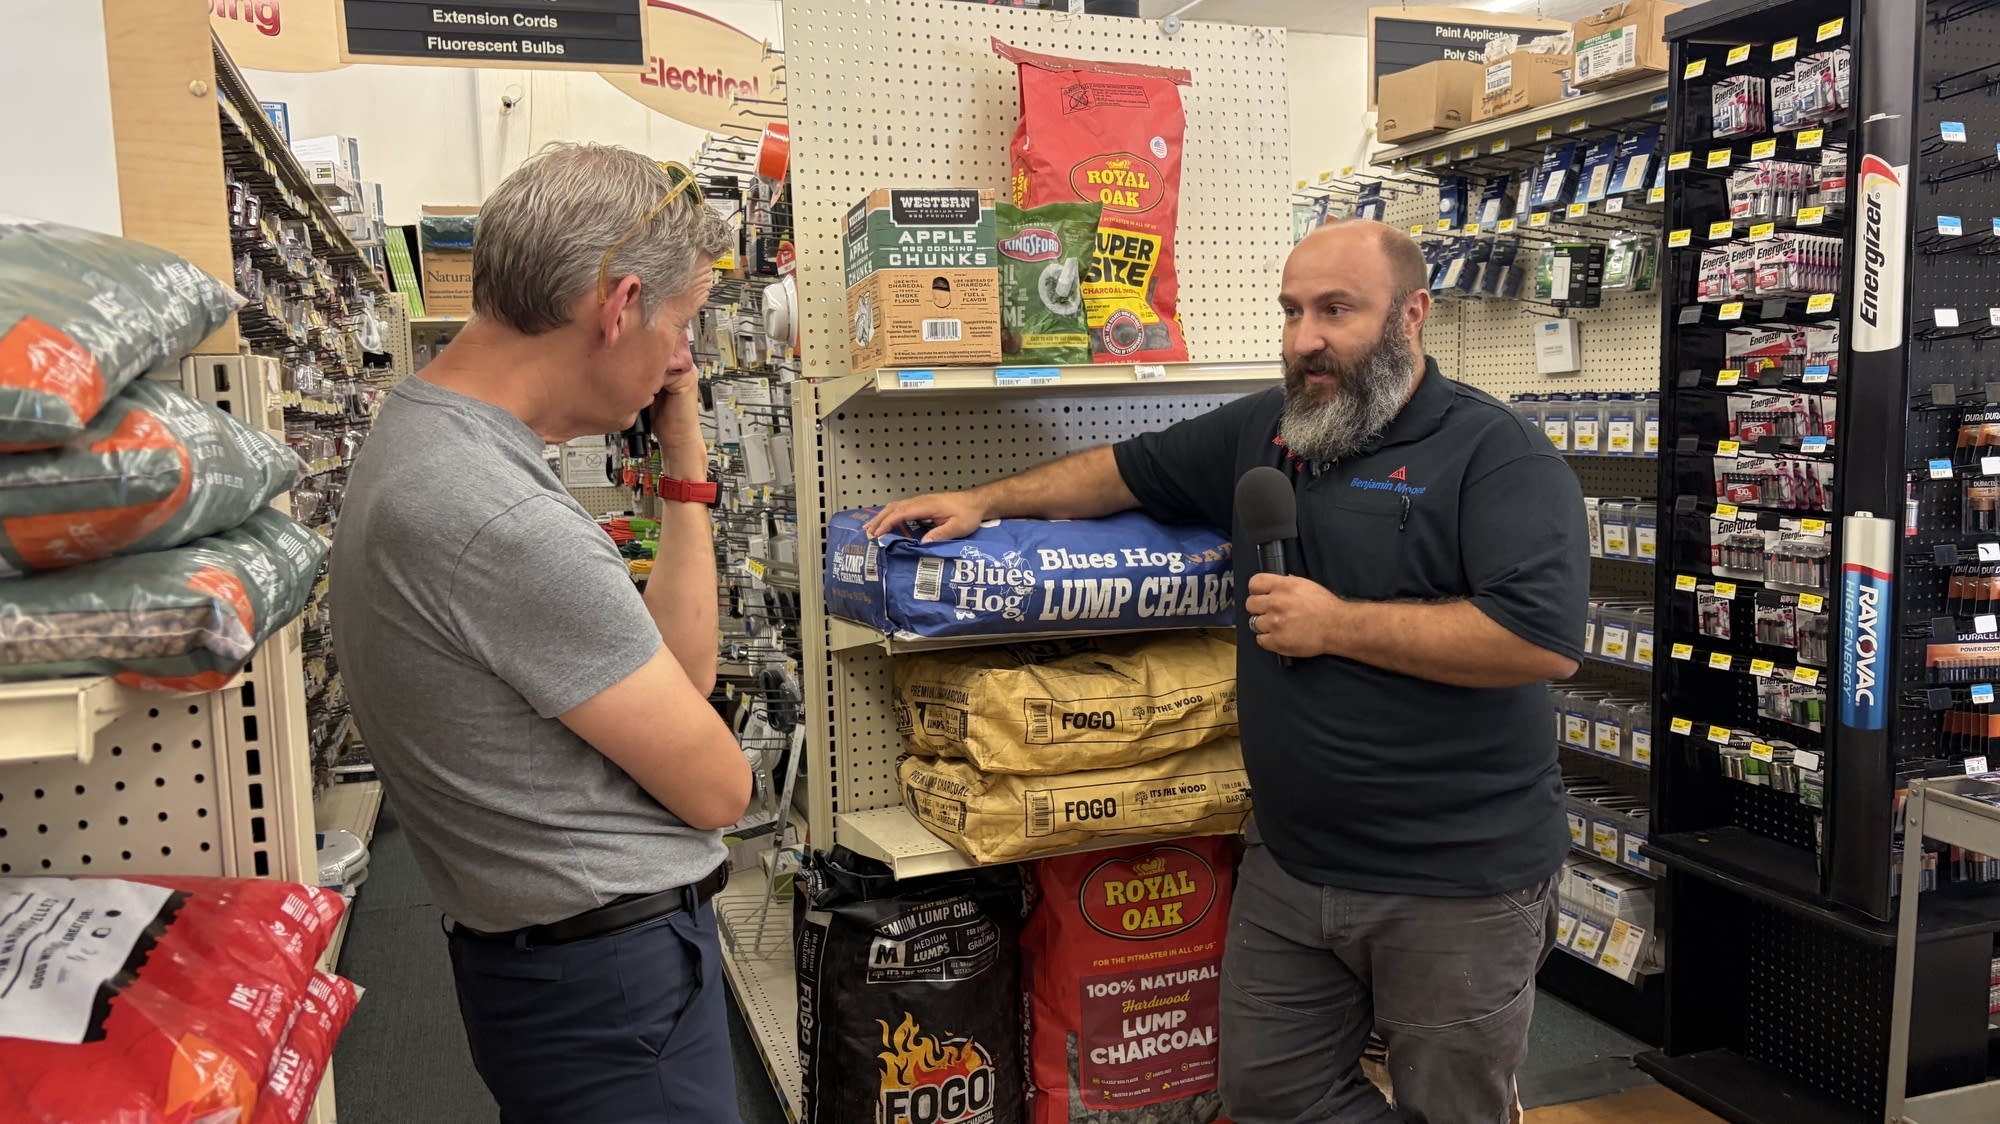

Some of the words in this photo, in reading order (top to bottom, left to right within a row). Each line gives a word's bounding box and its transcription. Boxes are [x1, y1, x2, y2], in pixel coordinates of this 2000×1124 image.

[433, 8, 509, 26] Extension
[513, 12, 558, 28] Cords
[1435, 26, 1462, 39] Paint
[427, 36, 518, 53] Fluorescent
[521, 40, 565, 55] Bulbs
[1444, 49, 1466, 62] Poly
[639, 56, 760, 100] Electrical
[1798, 56, 1831, 82] Energizer
[1714, 79, 1746, 104] Energizer
[1087, 169, 1150, 190] ROYAL
[899, 196, 970, 208] WESTERN
[1100, 188, 1140, 208] OAK
[850, 236, 869, 262] APPLE
[898, 230, 977, 244] APPLE
[902, 245, 924, 253] BBQ
[1004, 233, 1060, 256] KINGSFORD
[1096, 232, 1155, 262] UPER
[889, 253, 988, 266] CHUNKS
[1756, 238, 1797, 261] Energizer
[1859, 191, 1886, 328] Energizer
[848, 259, 873, 287] CHUNKS
[1083, 255, 1150, 288] SIZE
[1082, 286, 1123, 295] CHARCOAL
[1750, 331, 1781, 346] Energizer
[1751, 397, 1780, 409] Energizer
[1824, 424, 1832, 432] 12
[1736, 457, 1765, 471] Energizer
[1351, 477, 1393, 492] Benjamin
[953, 558, 1037, 587] Blues
[1037, 548, 1118, 571] Blues
[1120, 547, 1186, 574] Hog
[956, 586, 1025, 620] Hog
[1038, 577, 1134, 622] LUMP
[1136, 569, 1236, 619] CHARC
[1845, 579, 1856, 625] HIGH
[1855, 584, 1880, 706] RAYOVAC
[1982, 645, 2000, 653] BOOST
[1843, 626, 1854, 698] ENERGY
[1157, 703, 1172, 713] THE
[1174, 695, 1204, 709] WOOD
[1062, 710, 1116, 731] FOGO
[1149, 789, 1162, 798] IT'S
[1163, 787, 1177, 797] THE
[1178, 783, 1207, 794] WOOD
[1064, 797, 1118, 823] FOGO
[1103, 869, 1197, 907] ROYAL
[918, 906, 951, 927] LUMP
[1121, 901, 1184, 932] OAK
[61, 919, 84, 942] GREAT
[912, 931, 949, 951] MEDIUM
[874, 944, 898, 965] M
[912, 941, 951, 963] LUMPS
[1092, 959, 1110, 968] FOR
[1111, 956, 1126, 965] THE
[1126, 950, 1169, 963] PITMASTER
[1168, 949, 1177, 957] IN
[1178, 946, 1193, 955] ALL
[1193, 944, 1203, 953] OF
[1204, 943, 1214, 951] US
[916, 966, 942, 974] WOOD
[1086, 979, 1136, 998] 100%
[1140, 964, 1220, 992] NATURAL
[1021, 990, 1030, 1031] 100%
[1121, 988, 1192, 1014] Hardwood
[799, 981, 814, 1047] FOGO
[1122, 1009, 1187, 1039] LUMP
[1089, 1025, 1218, 1065] CHARCOAL
[267, 1048, 301, 1097] APPLE
[1022, 1034, 1035, 1102] NATURAL
[885, 1067, 990, 1124] FOGO
